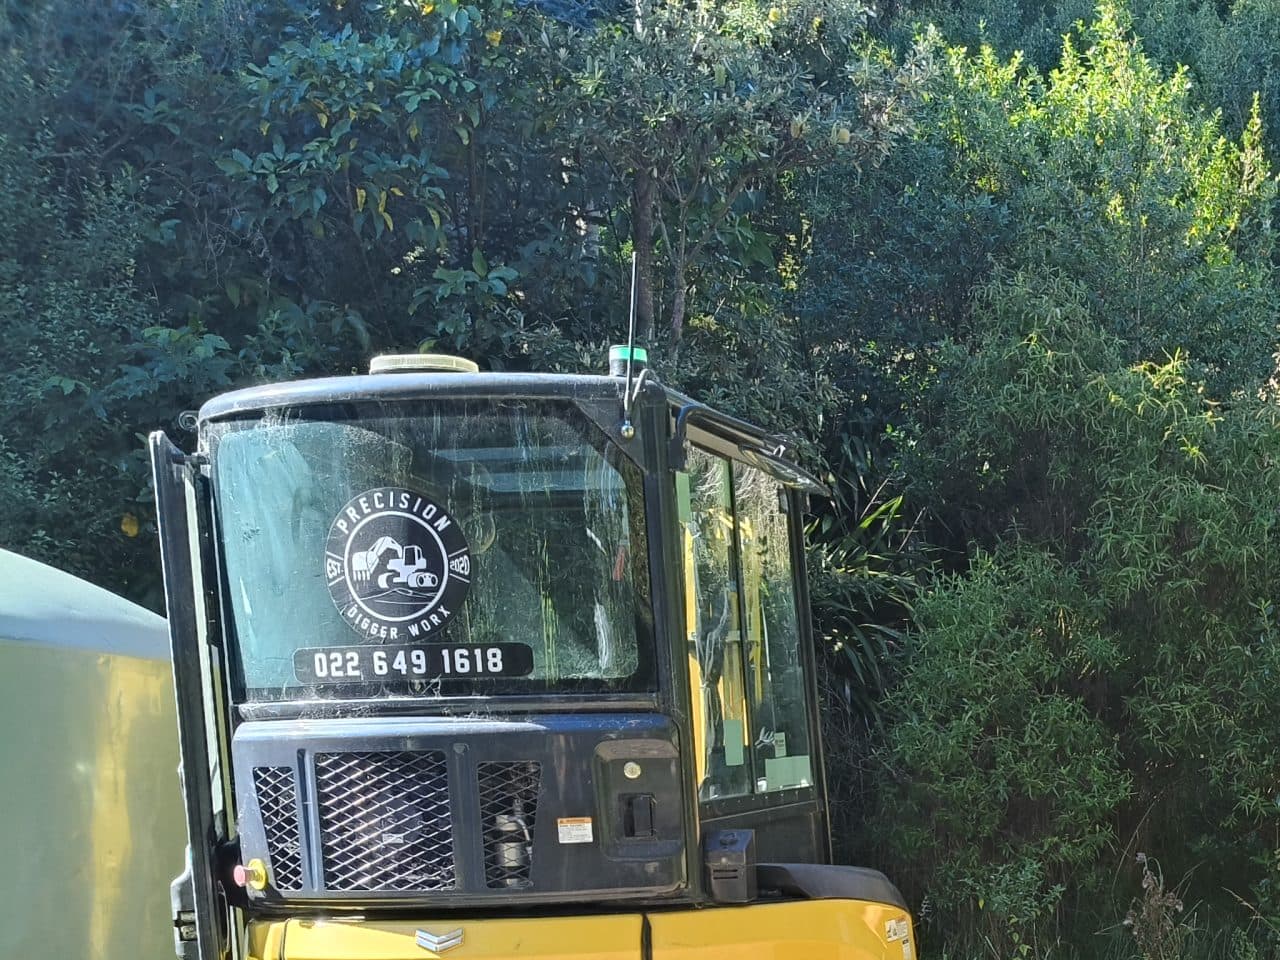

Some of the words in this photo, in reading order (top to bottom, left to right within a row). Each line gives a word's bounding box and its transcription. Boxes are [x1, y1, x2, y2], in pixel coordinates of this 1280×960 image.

[337, 491, 452, 535] PRECISION
[326, 558, 345, 579] EST.
[449, 554, 471, 576] 2020
[347, 604, 398, 640] DIGGER
[408, 605, 452, 638] WORX
[314, 651, 361, 678] 022
[373, 649, 427, 676] 649
[441, 648, 504, 674] 1618
